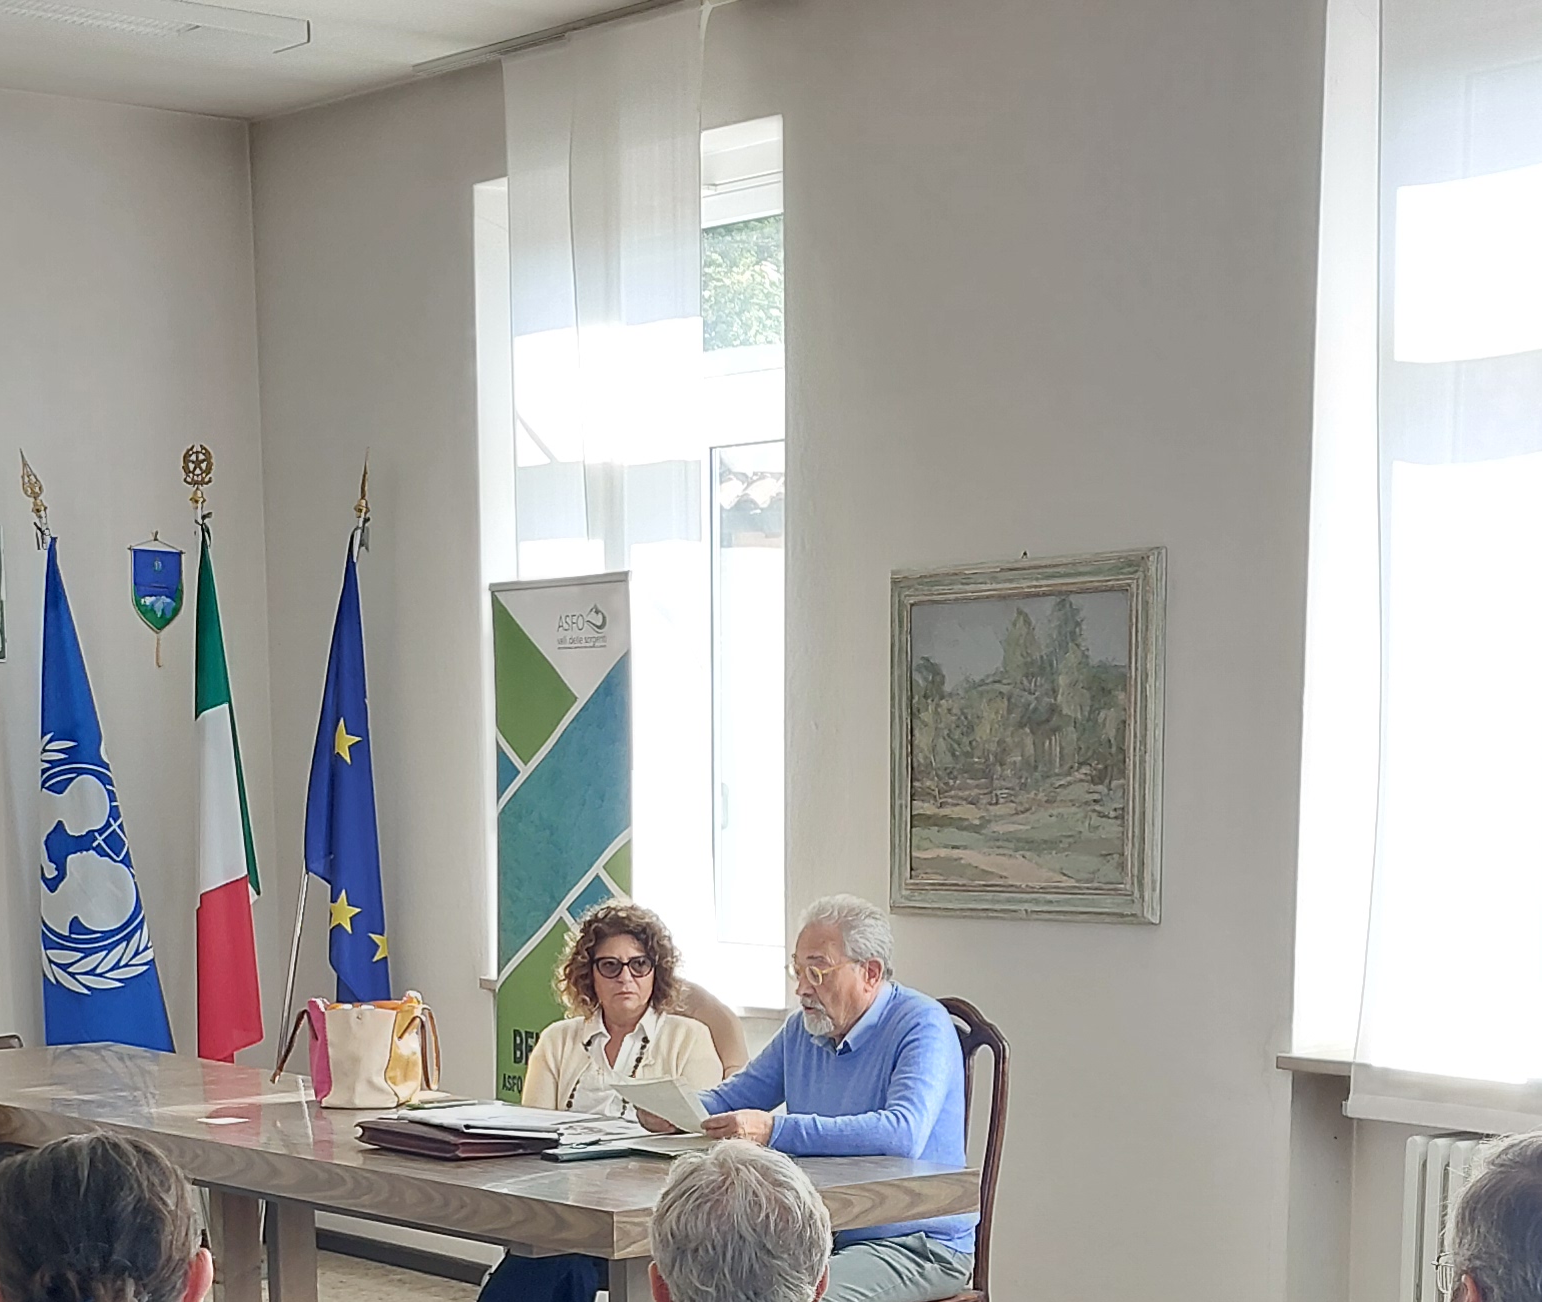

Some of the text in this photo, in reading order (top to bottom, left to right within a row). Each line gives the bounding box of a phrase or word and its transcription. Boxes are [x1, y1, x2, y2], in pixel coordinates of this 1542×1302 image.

[556, 613, 585, 632] ASFO
[513, 1028, 541, 1065] BE
[502, 1073, 523, 1094] ASFO
